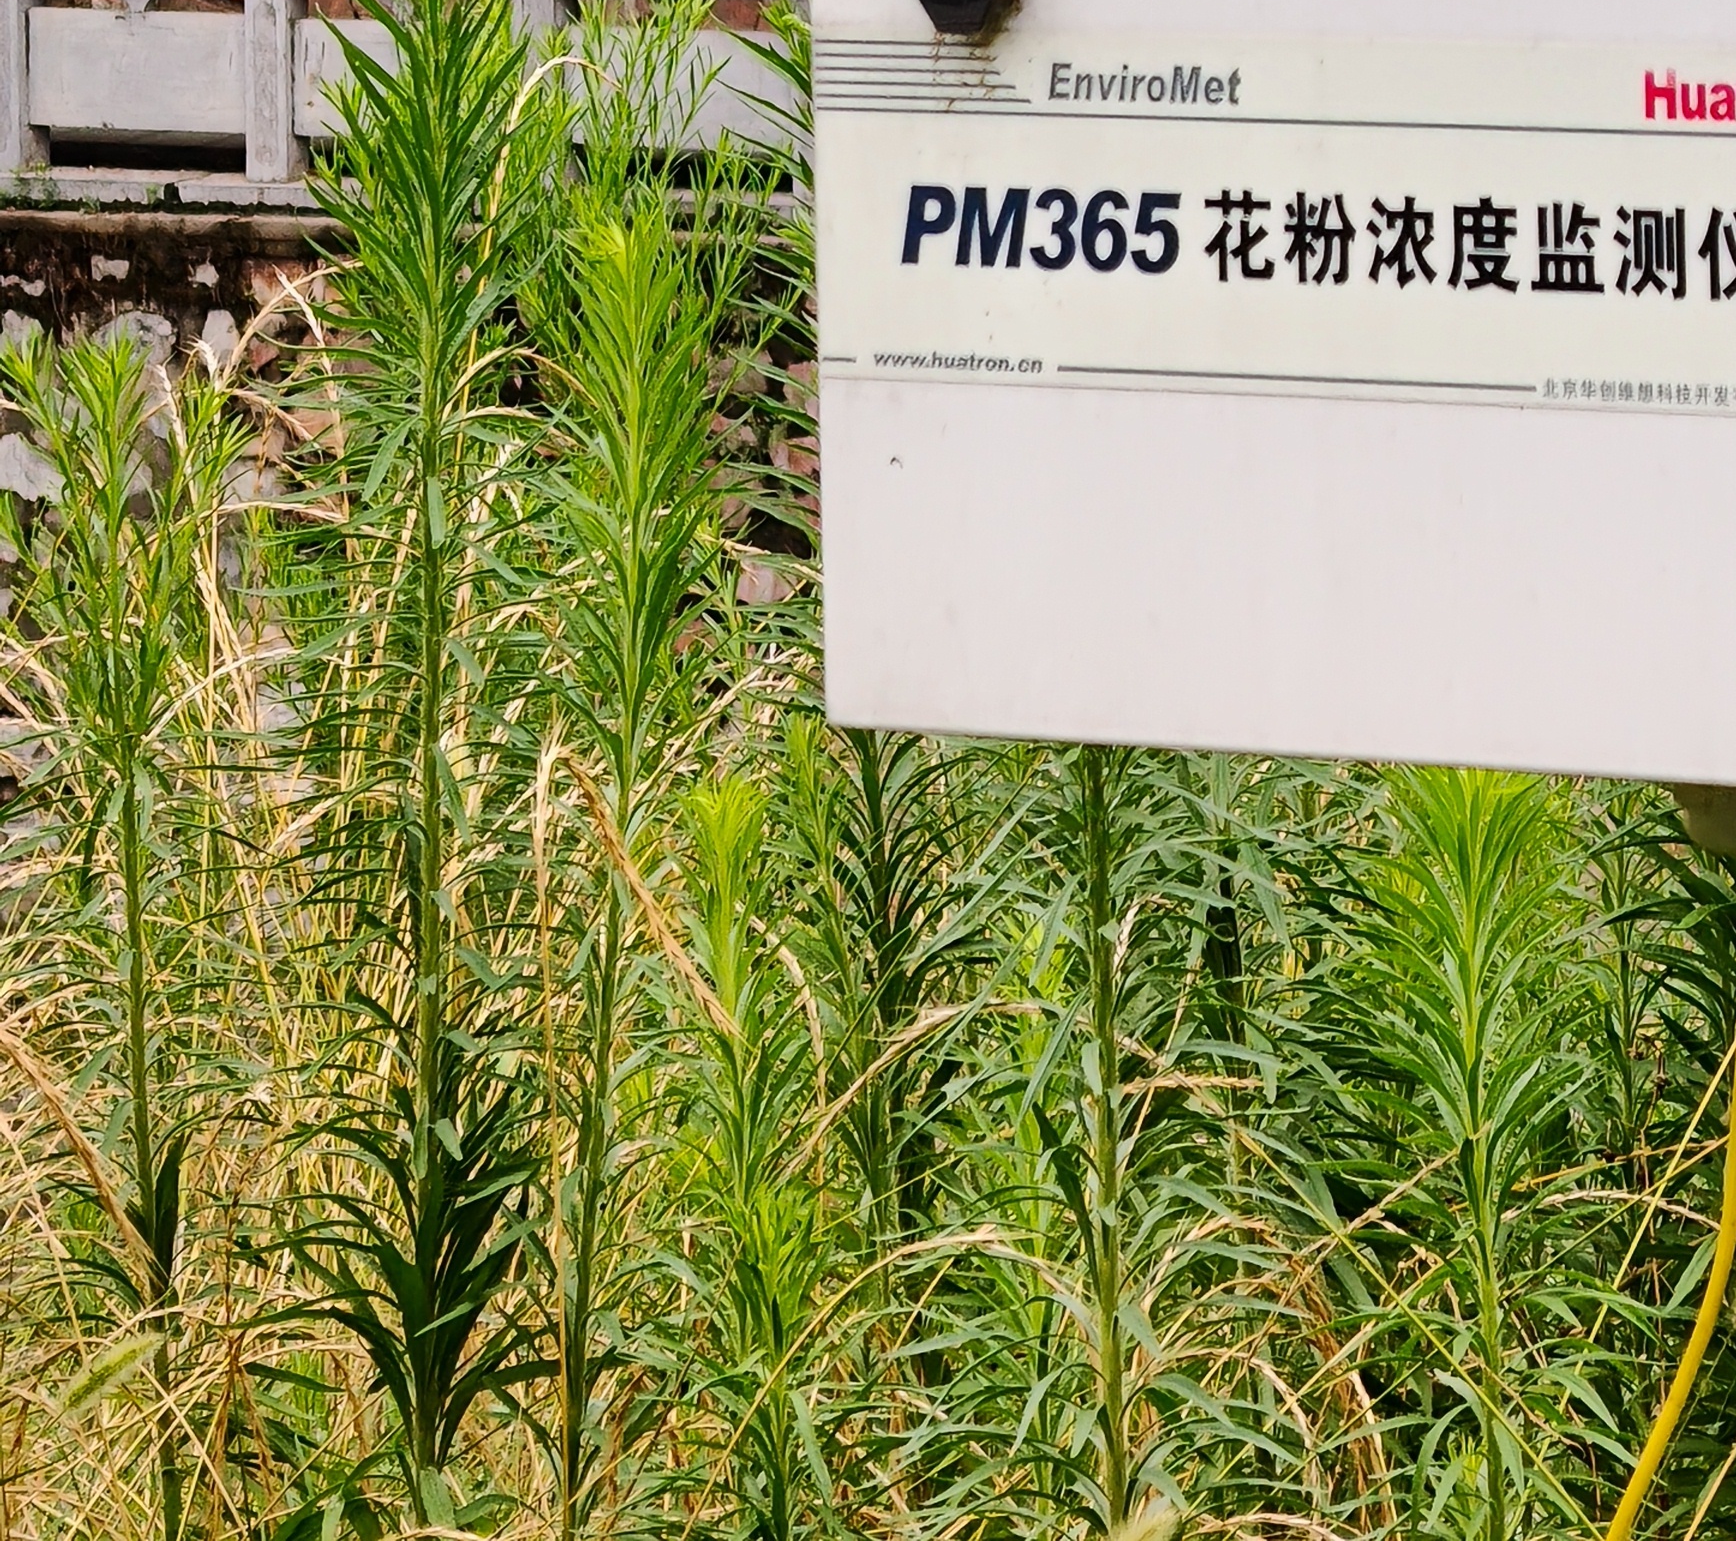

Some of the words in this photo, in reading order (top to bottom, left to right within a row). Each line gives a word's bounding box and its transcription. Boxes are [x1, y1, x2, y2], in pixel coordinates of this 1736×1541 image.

[1048, 62, 1241, 105] EnviroMet
[901, 184, 1182, 274] PM365
[873, 351, 1044, 374] www.huatron.cn
